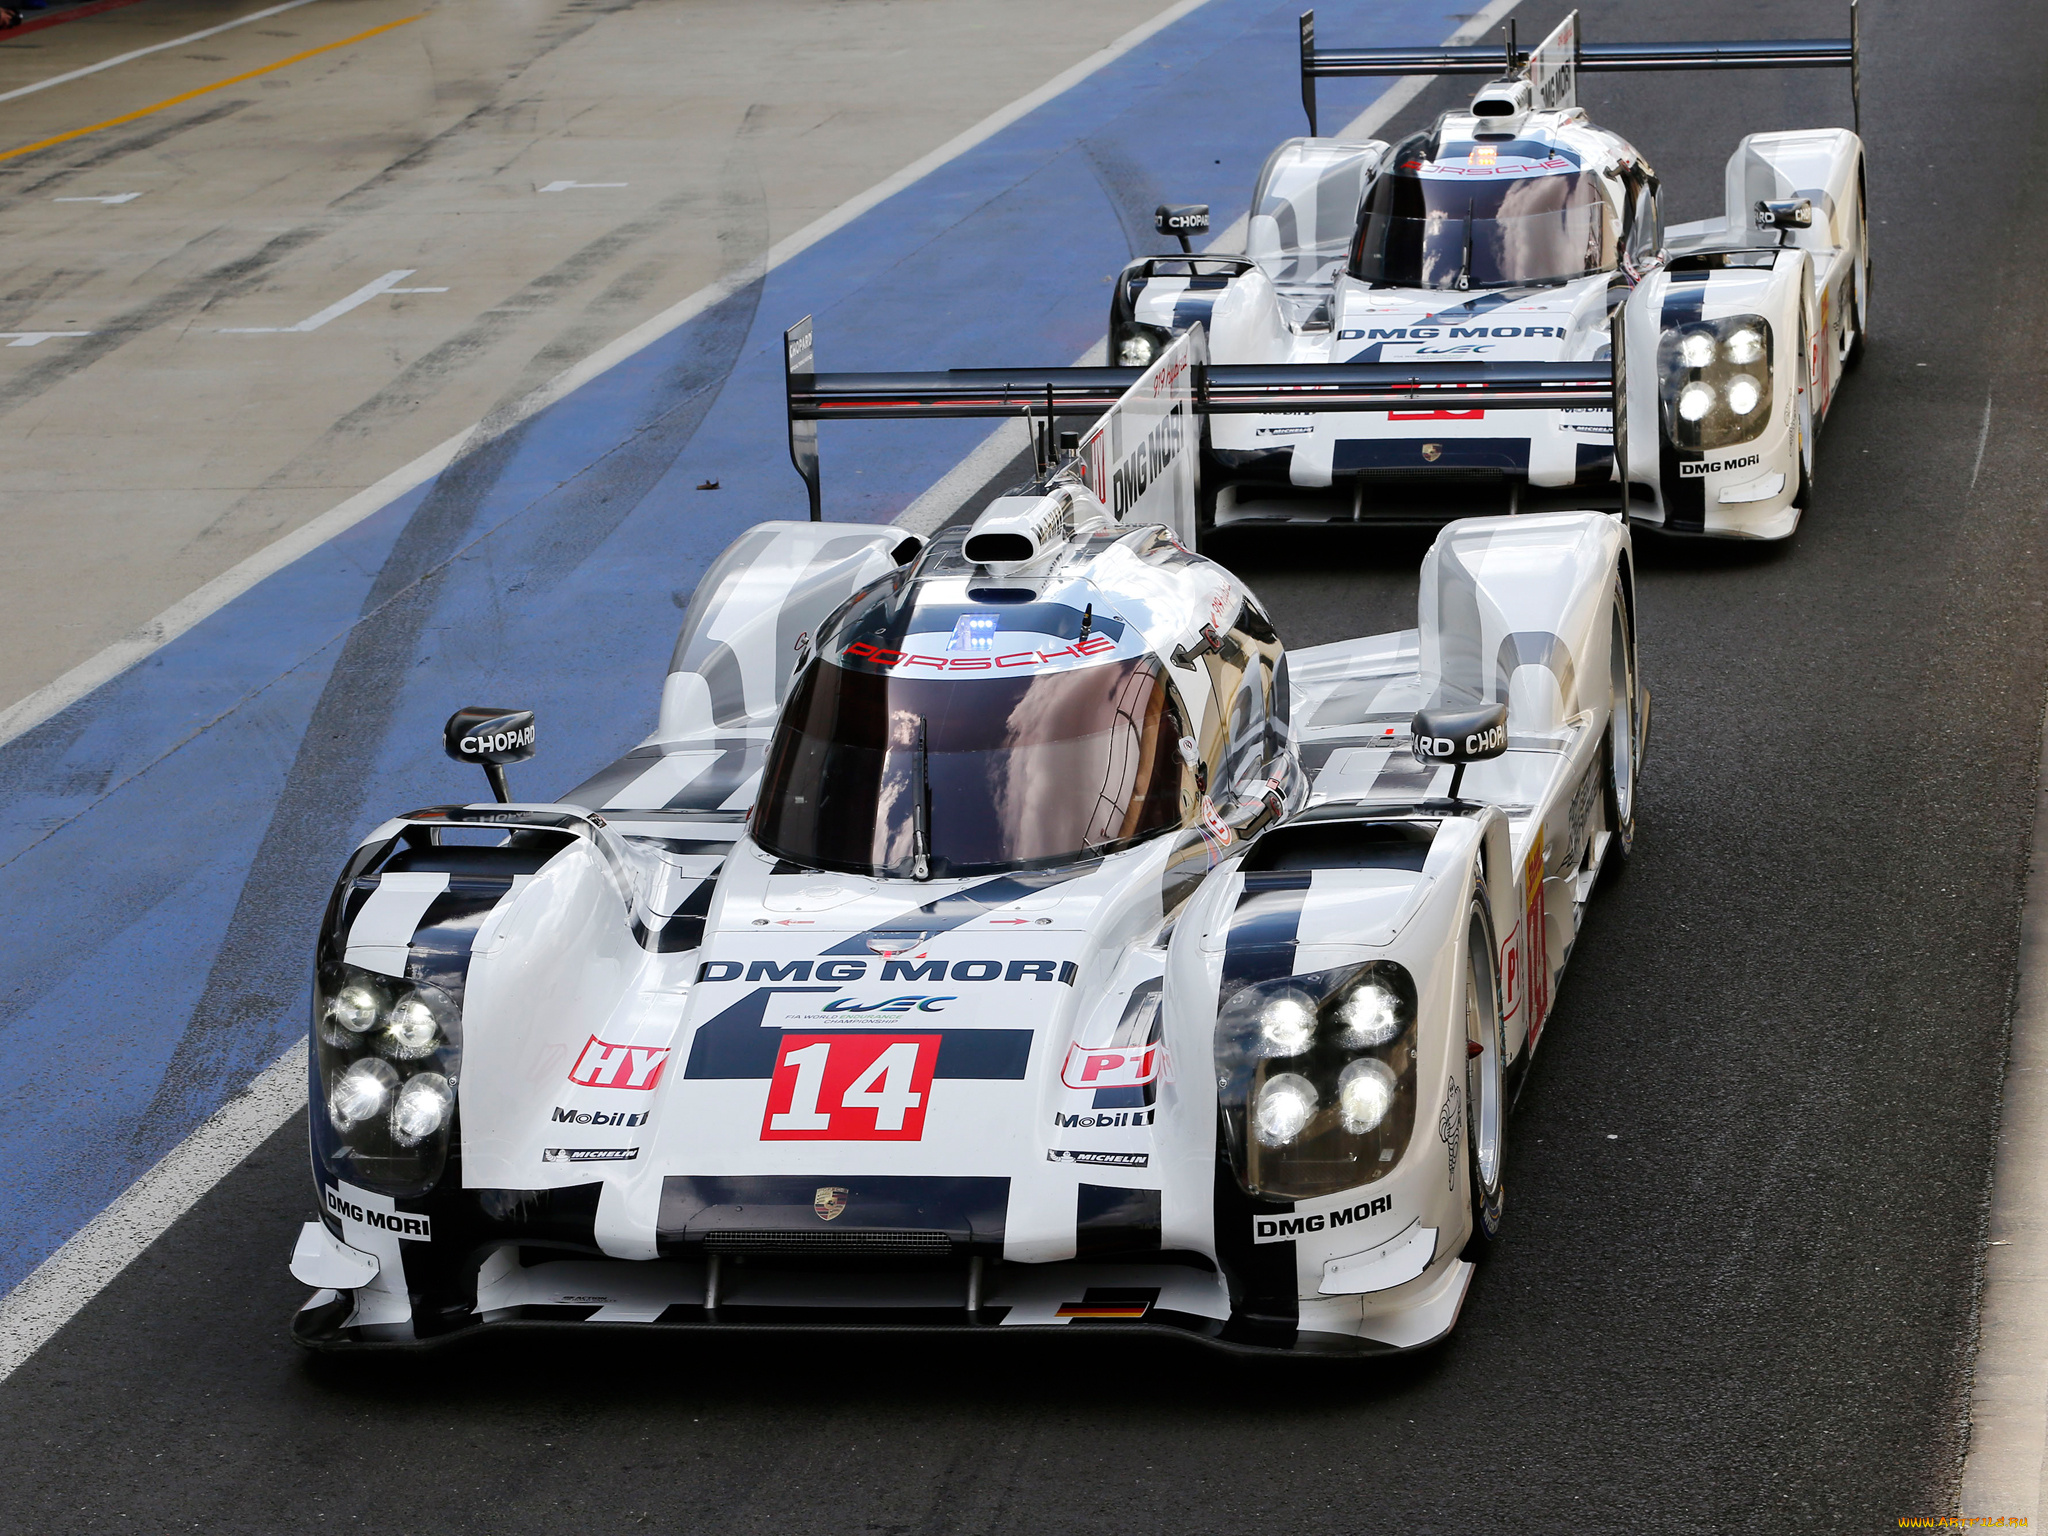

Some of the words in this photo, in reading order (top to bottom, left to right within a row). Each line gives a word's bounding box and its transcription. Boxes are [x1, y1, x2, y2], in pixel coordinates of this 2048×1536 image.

[1400, 158, 1570, 176] PORSCHE
[1337, 328, 1440, 341] DMG
[1449, 326, 1567, 340] MORI
[1113, 441, 1148, 522] DMG
[1148, 399, 1185, 484] MORI
[1682, 462, 1721, 475] DMG
[1724, 454, 1760, 471] MORI
[842, 636, 1116, 671] PORSCHE
[460, 724, 535, 754] CHOPARD
[694, 960, 868, 984] DMG
[879, 960, 1079, 988] MORI
[1508, 938, 1520, 1003] P1
[822, 995, 958, 1012] WEC
[572, 1039, 672, 1087] HY
[1080, 1048, 1157, 1082] P1
[769, 1042, 922, 1131] 14
[552, 1106, 626, 1127] Mobil
[1054, 1111, 1129, 1128] Mobil
[571, 1150, 638, 1159] MICHELIN
[1076, 1153, 1148, 1164] MICHELIN
[327, 1191, 364, 1223] DMG
[366, 1209, 430, 1236] MORI
[1257, 1214, 1325, 1238] DMG
[1329, 1193, 1393, 1229] MORI
